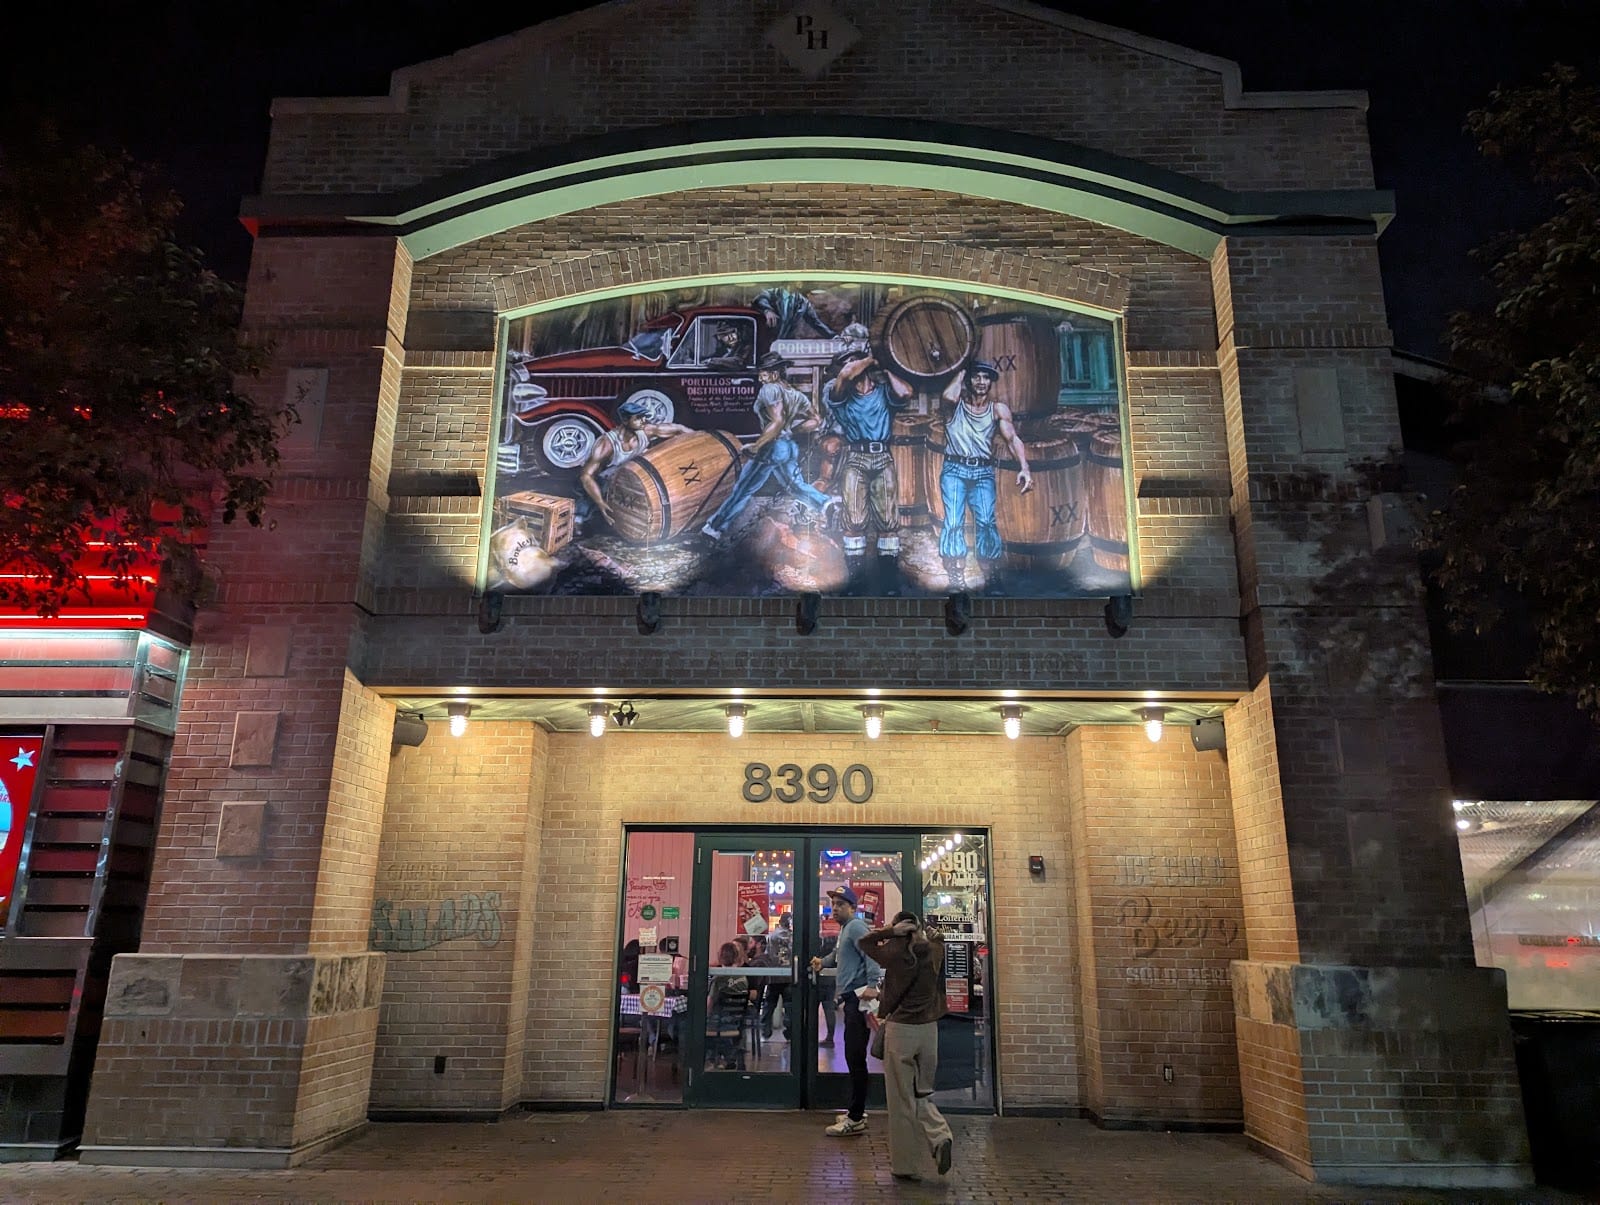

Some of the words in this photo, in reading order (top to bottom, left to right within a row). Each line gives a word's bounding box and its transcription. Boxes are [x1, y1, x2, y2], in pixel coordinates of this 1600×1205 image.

[687, 386, 755, 396] DISTRIBUTION
[1050, 501, 1079, 528] XX
[508, 537, 533, 566] Barley
[742, 762, 874, 804] 8390
[930, 872, 943, 887] LA
[1126, 967, 1178, 986] SOLD
